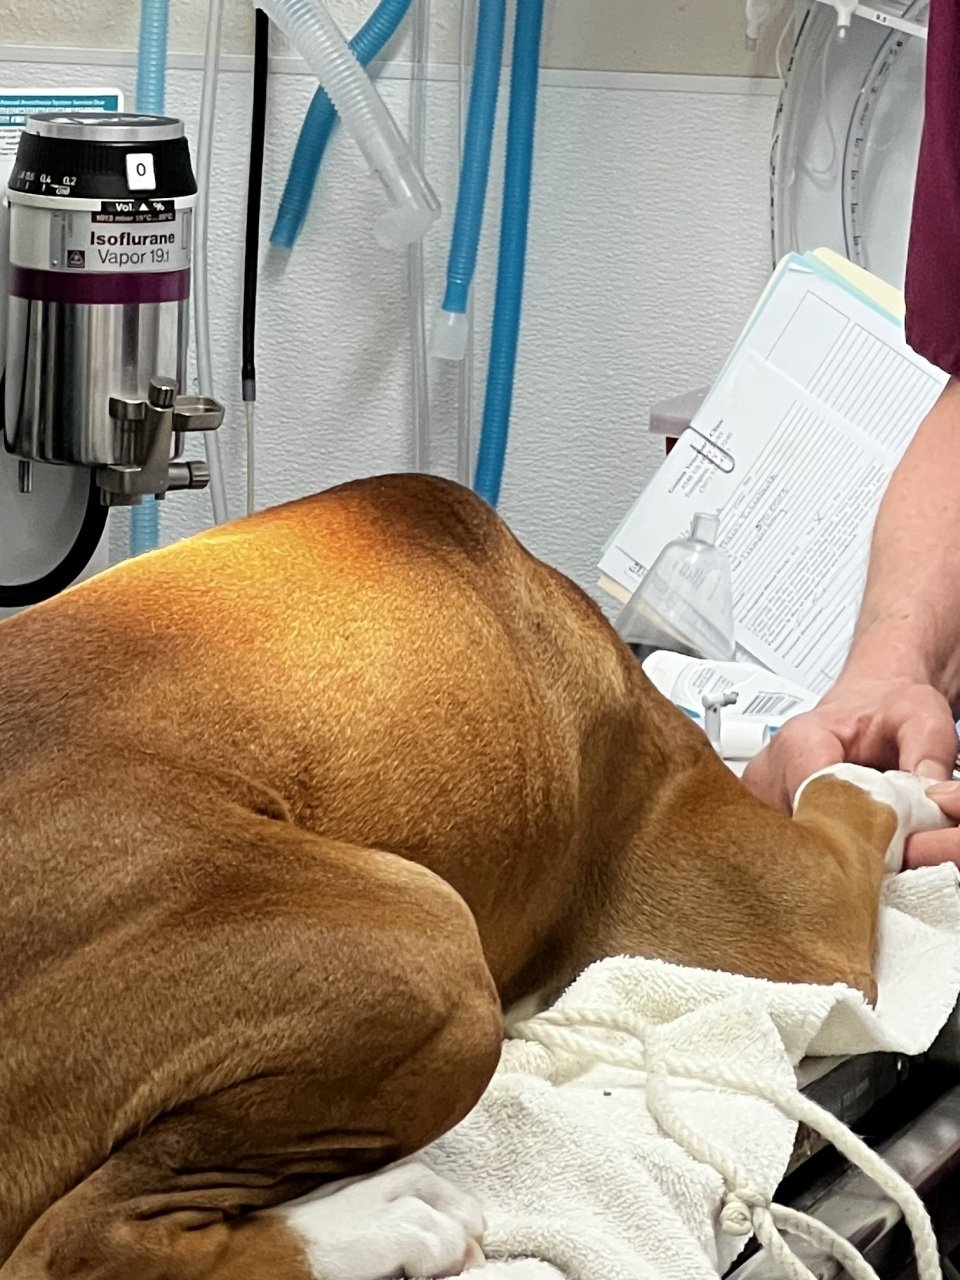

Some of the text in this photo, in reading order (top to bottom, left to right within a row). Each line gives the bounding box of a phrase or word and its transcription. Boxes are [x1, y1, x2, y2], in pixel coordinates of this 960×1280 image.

[136, 163, 146, 177] 0
[62, 176, 77, 186] 0.2
[152, 202, 165, 211] %
[90, 231, 175, 246] Isoflurane
[97, 248, 170, 267] Vapor 19.1
